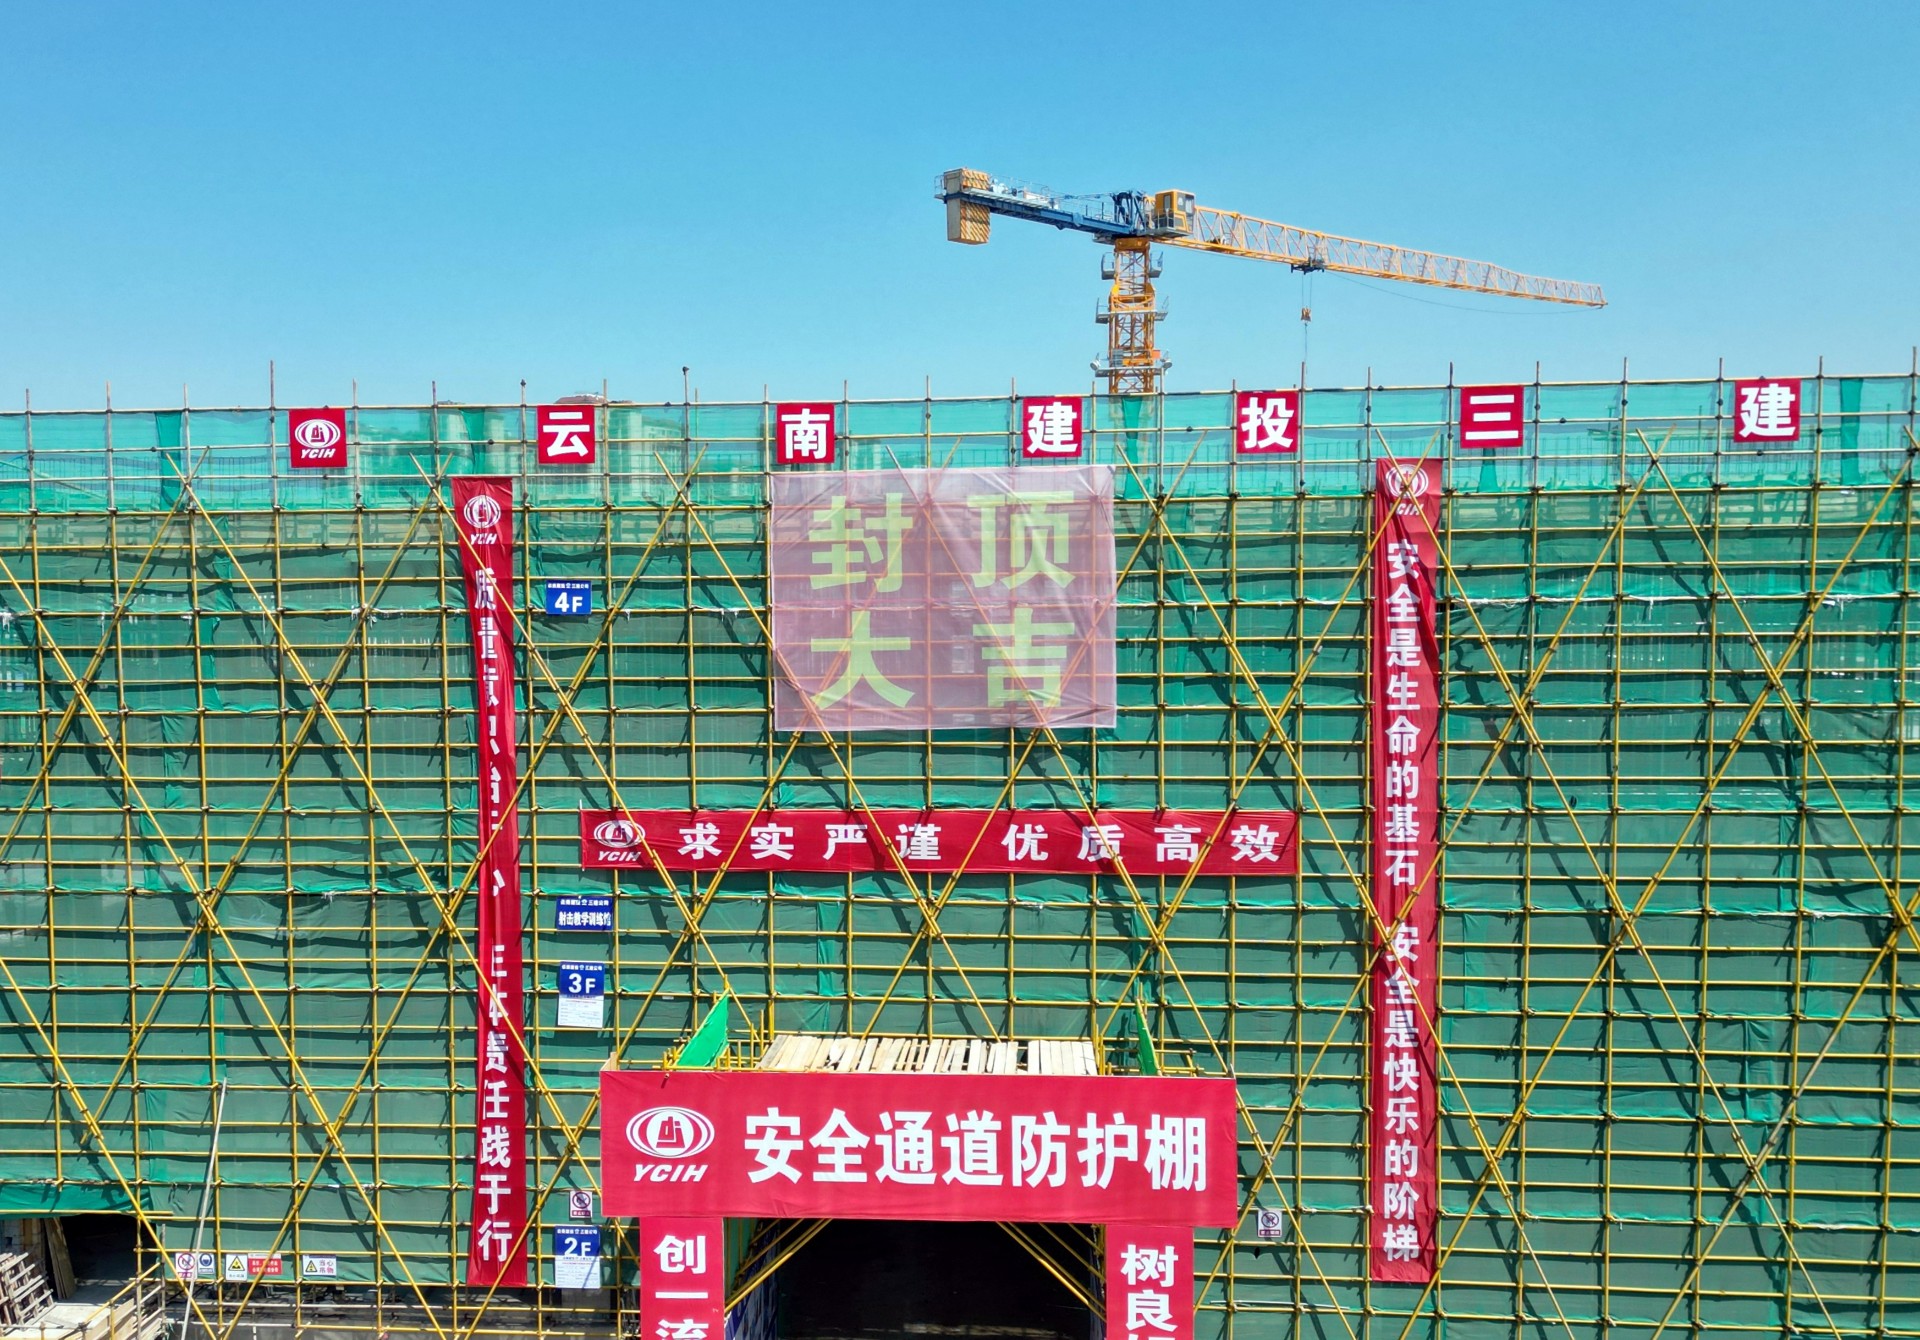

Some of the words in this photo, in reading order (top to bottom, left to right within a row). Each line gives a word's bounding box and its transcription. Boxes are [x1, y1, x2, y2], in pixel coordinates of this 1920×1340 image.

[543, 412, 589, 456] 云
[781, 409, 831, 459] 南
[1027, 402, 1078, 454] 建
[1241, 397, 1294, 449] 投
[1466, 395, 1519, 440] 三
[1740, 383, 1796, 438] 建
[301, 448, 336, 459] YCIH
[1390, 502, 1424, 516] CIH
[809, 491, 1076, 592] 封顶
[555, 592, 583, 613] 4F
[810, 608, 1075, 710] 大吉
[1384, 539, 1421, 886] 安全是生命的基石
[598, 851, 641, 862] YCIH
[677, 822, 942, 861] 求实严谨
[1001, 822, 1280, 862] 优质高效
[568, 973, 596, 993] 3F
[1383, 922, 1420, 1262] 安全是快乐的阶梯
[744, 1107, 1207, 1192] 安全通道防护棚
[633, 1164, 708, 1182] YCIH
[564, 1237, 591, 1256] 2F
[1120, 1244, 1179, 1340] 树良
